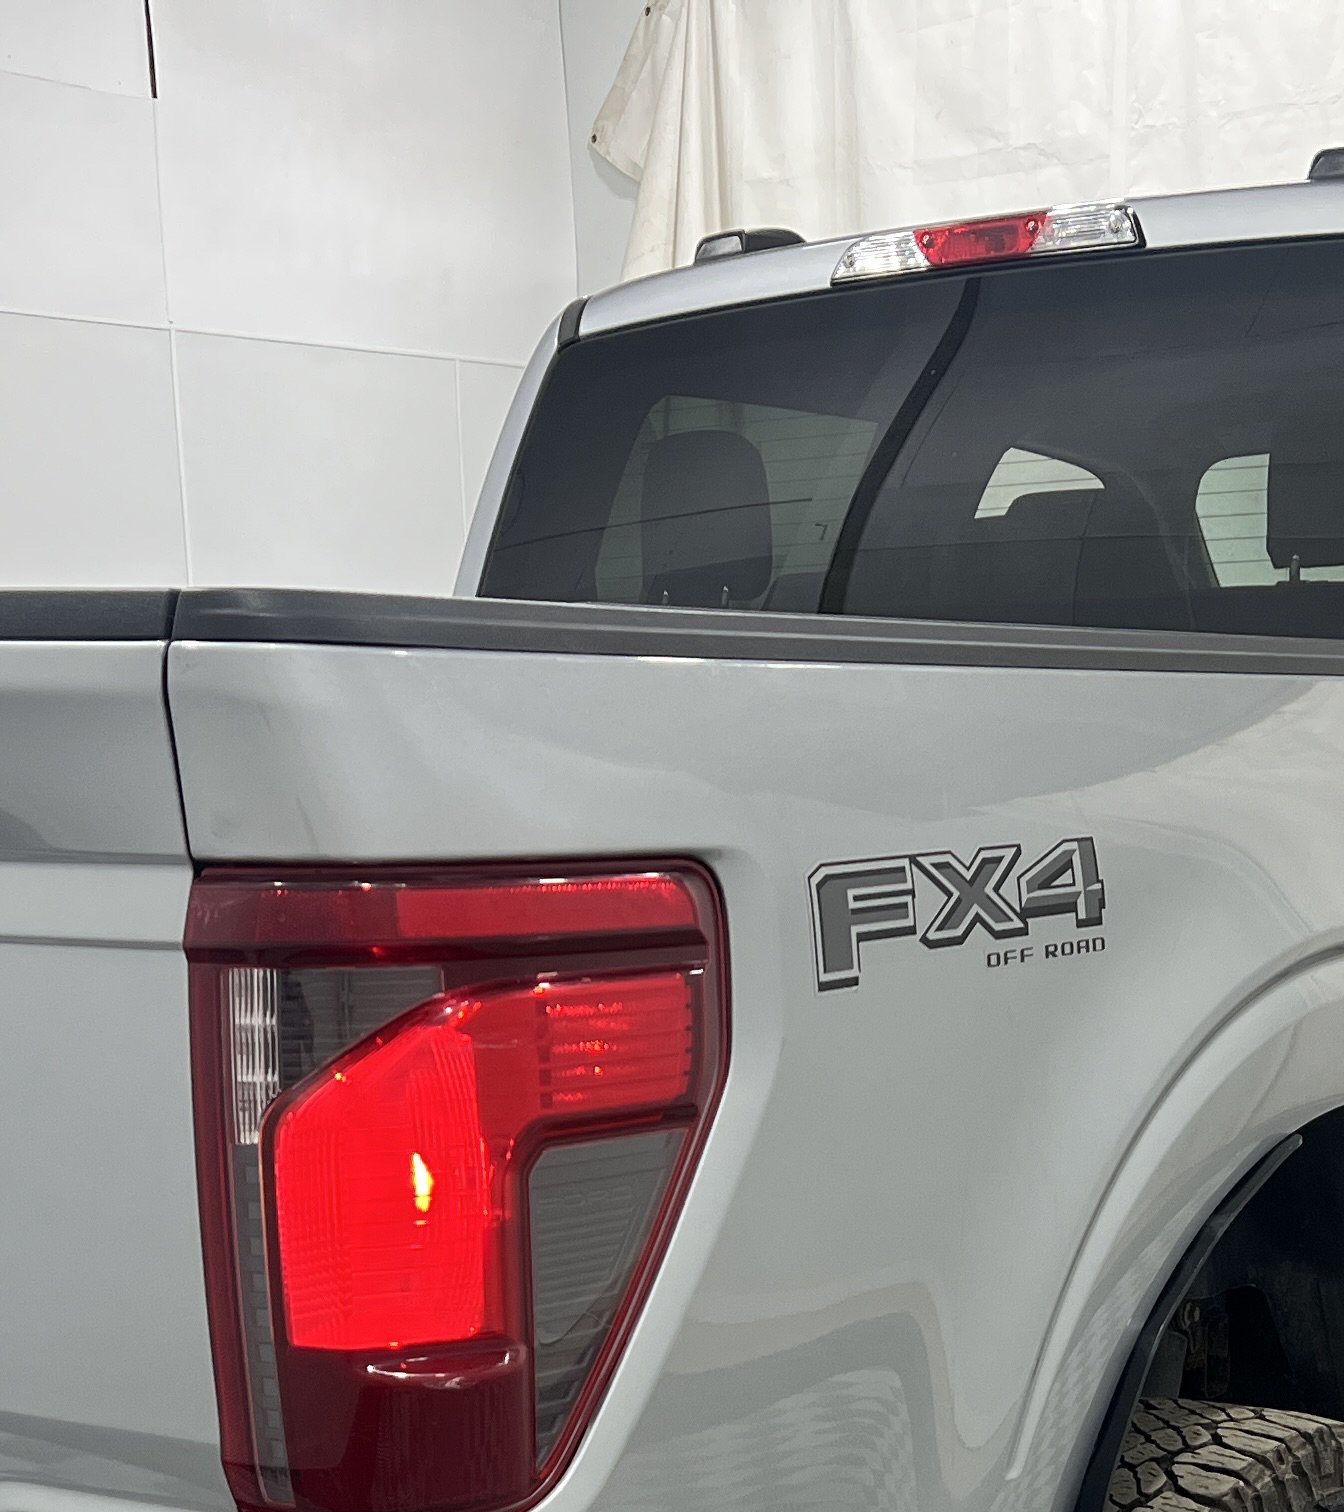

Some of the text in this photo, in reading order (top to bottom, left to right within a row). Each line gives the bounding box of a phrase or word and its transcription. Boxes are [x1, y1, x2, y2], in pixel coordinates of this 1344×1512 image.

[808, 837, 1106, 991] FX4
[986, 936, 1105, 968] OFF ROAD
